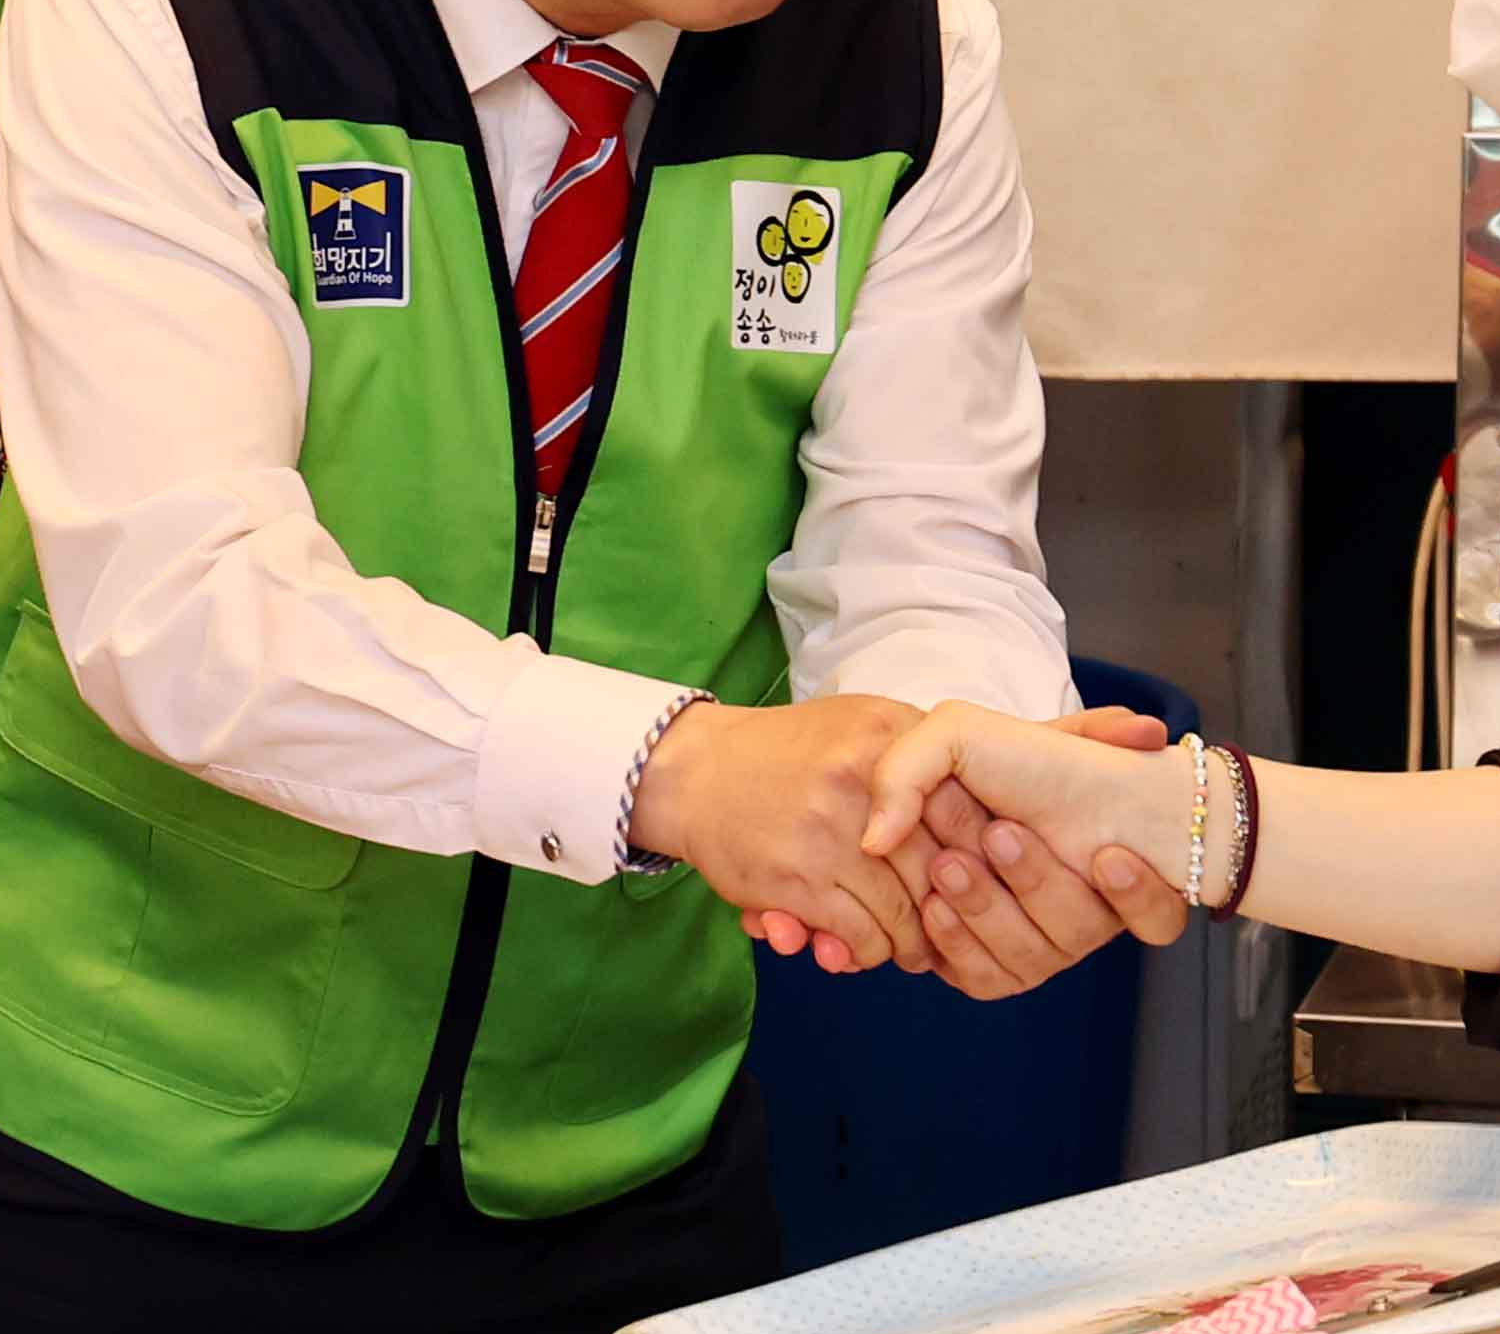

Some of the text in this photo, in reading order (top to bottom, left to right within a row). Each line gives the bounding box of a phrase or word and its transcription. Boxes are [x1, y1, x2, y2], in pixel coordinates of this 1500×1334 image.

[312, 231, 392, 273] 희망지기
[348, 272, 360, 284] Of
[363, 272, 393, 286] Hope
[735, 269, 775, 301] 정이
[737, 308, 776, 345] 송송
